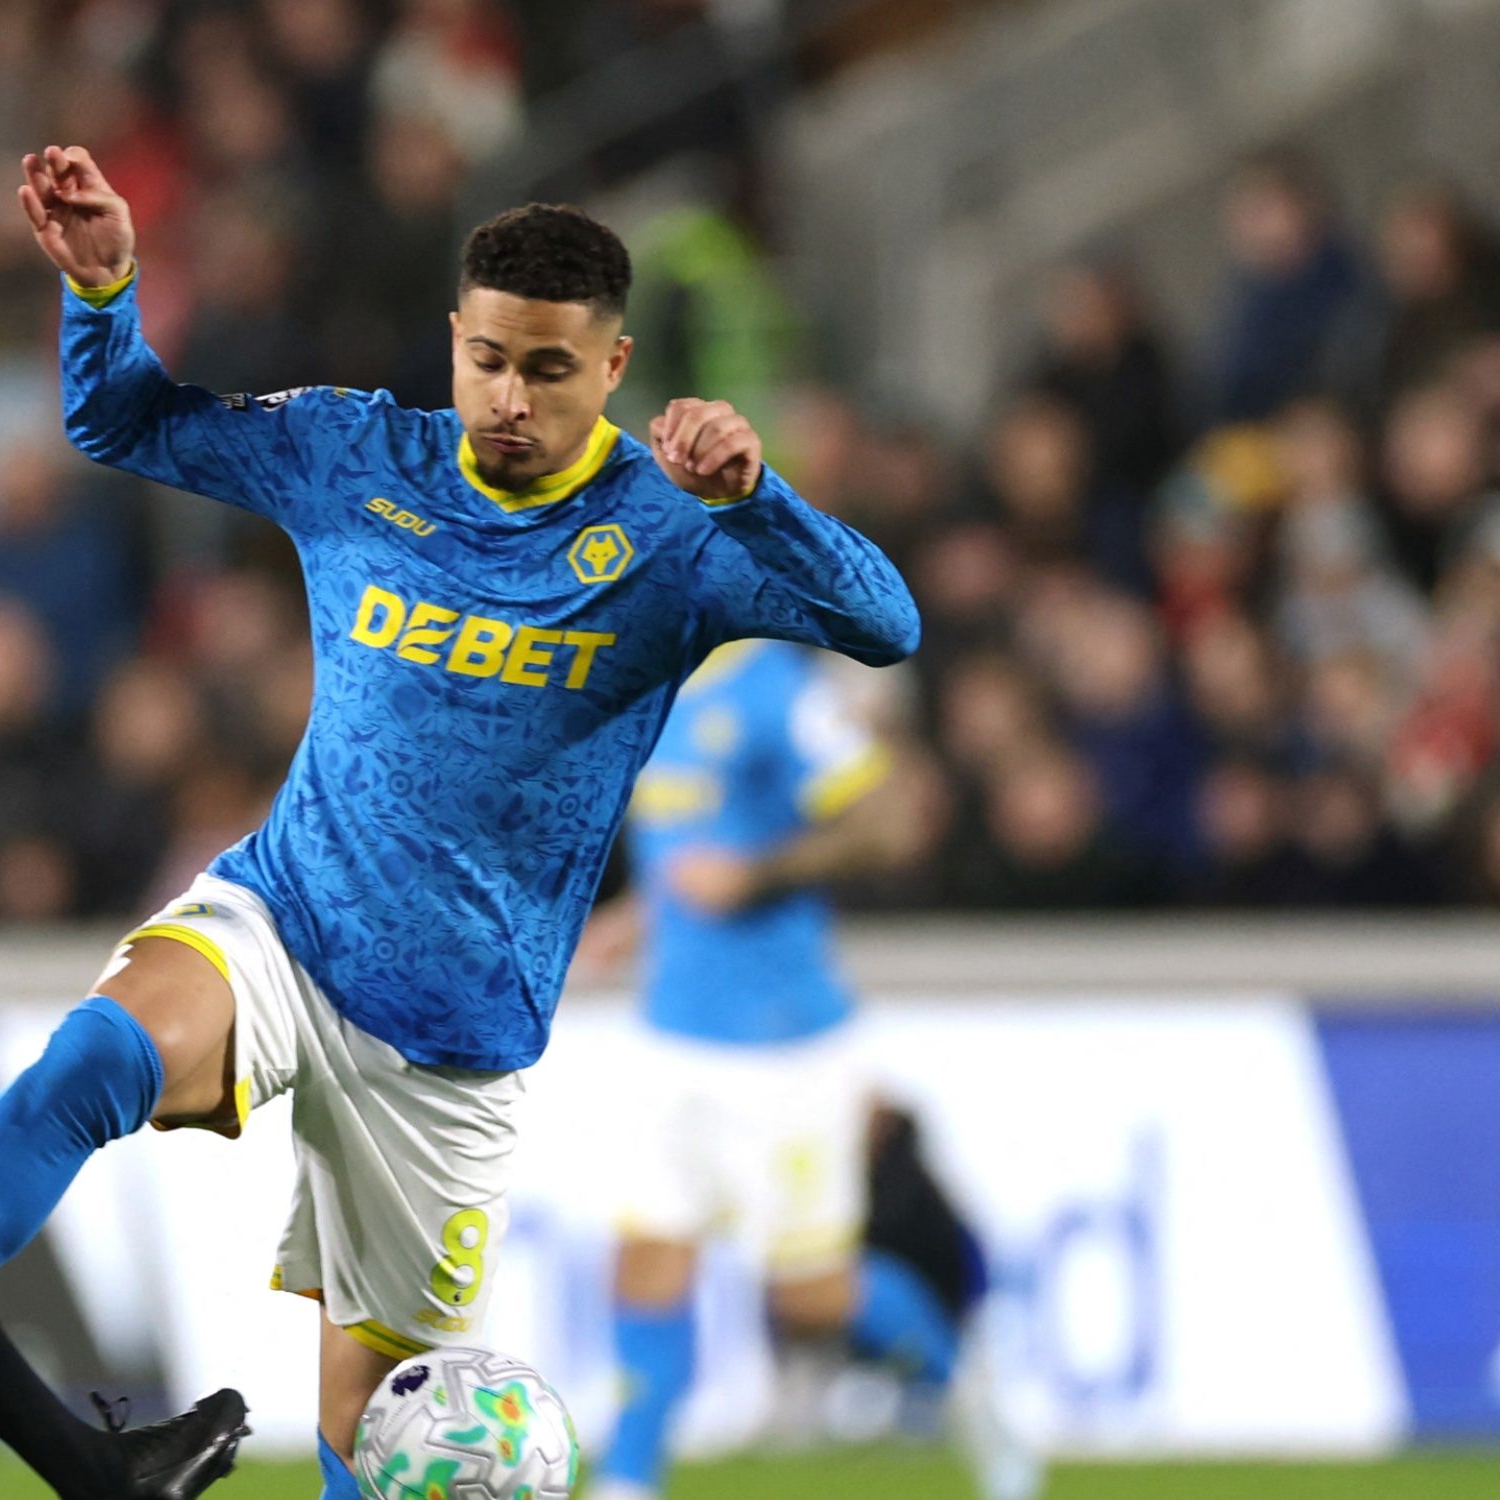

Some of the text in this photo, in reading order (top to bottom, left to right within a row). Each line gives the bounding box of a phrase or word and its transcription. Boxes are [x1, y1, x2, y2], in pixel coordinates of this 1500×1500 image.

[364, 497, 437, 536] SUDU
[349, 584, 617, 689] DEBET
[431, 1208, 488, 1306] 8
